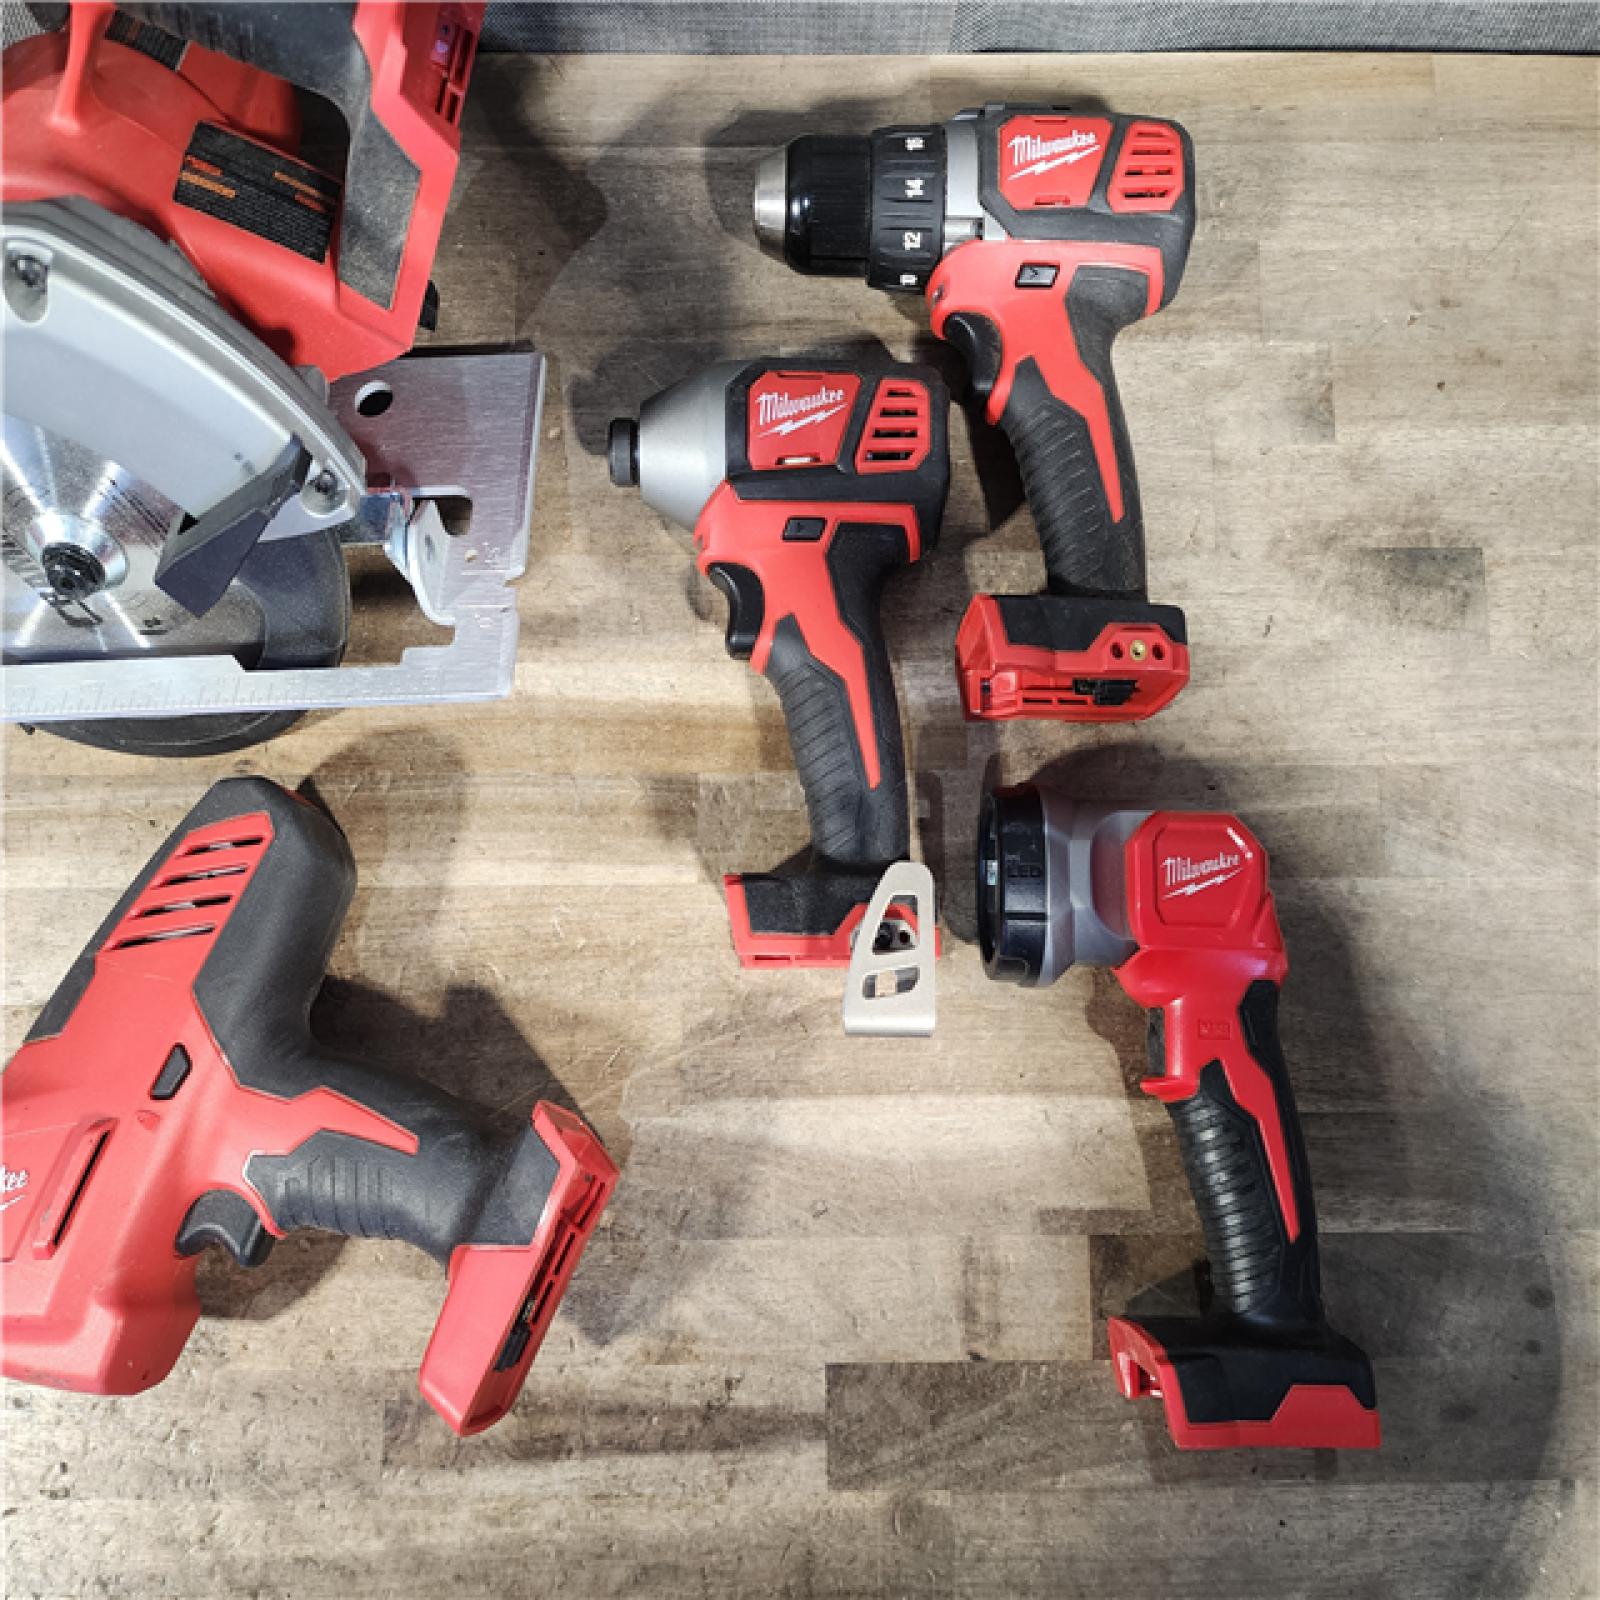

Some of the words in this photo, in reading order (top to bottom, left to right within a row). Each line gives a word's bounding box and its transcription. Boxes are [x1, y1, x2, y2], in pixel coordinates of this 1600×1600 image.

[1007, 129, 1096, 167] Milwaukee
[905, 177, 925, 198] 14
[903, 231, 922, 251] 12
[755, 385, 844, 426] Milwaukee
[1160, 851, 1239, 887] Milwaukee
